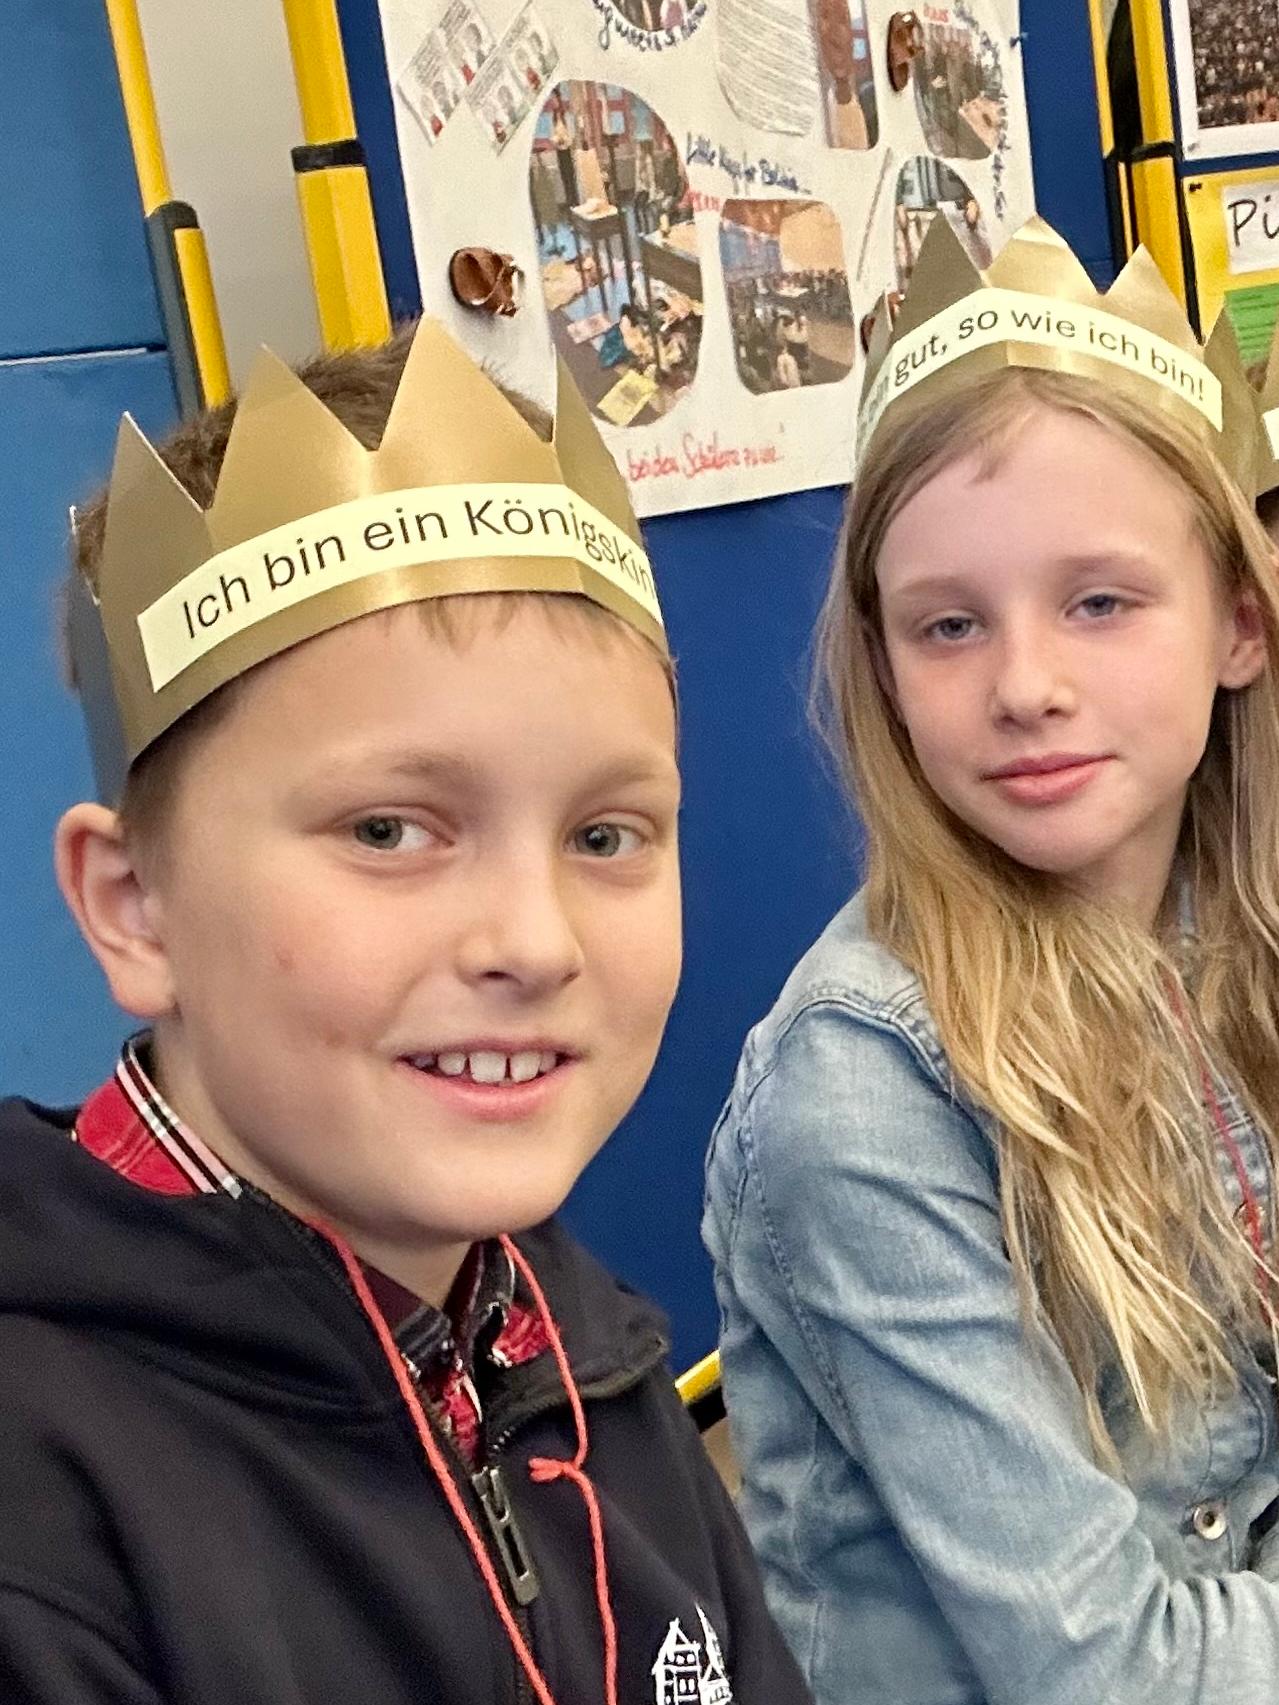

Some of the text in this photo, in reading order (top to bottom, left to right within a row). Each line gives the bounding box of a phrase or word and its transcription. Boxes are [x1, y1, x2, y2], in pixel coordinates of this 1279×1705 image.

[893, 333, 949, 387] gut,
[957, 309, 999, 341] so
[1010, 309, 1076, 339] wie
[1087, 320, 1140, 362] ich
[1150, 348, 1204, 402] bin!
[182, 498, 656, 640] Ich bin ein Königskin
